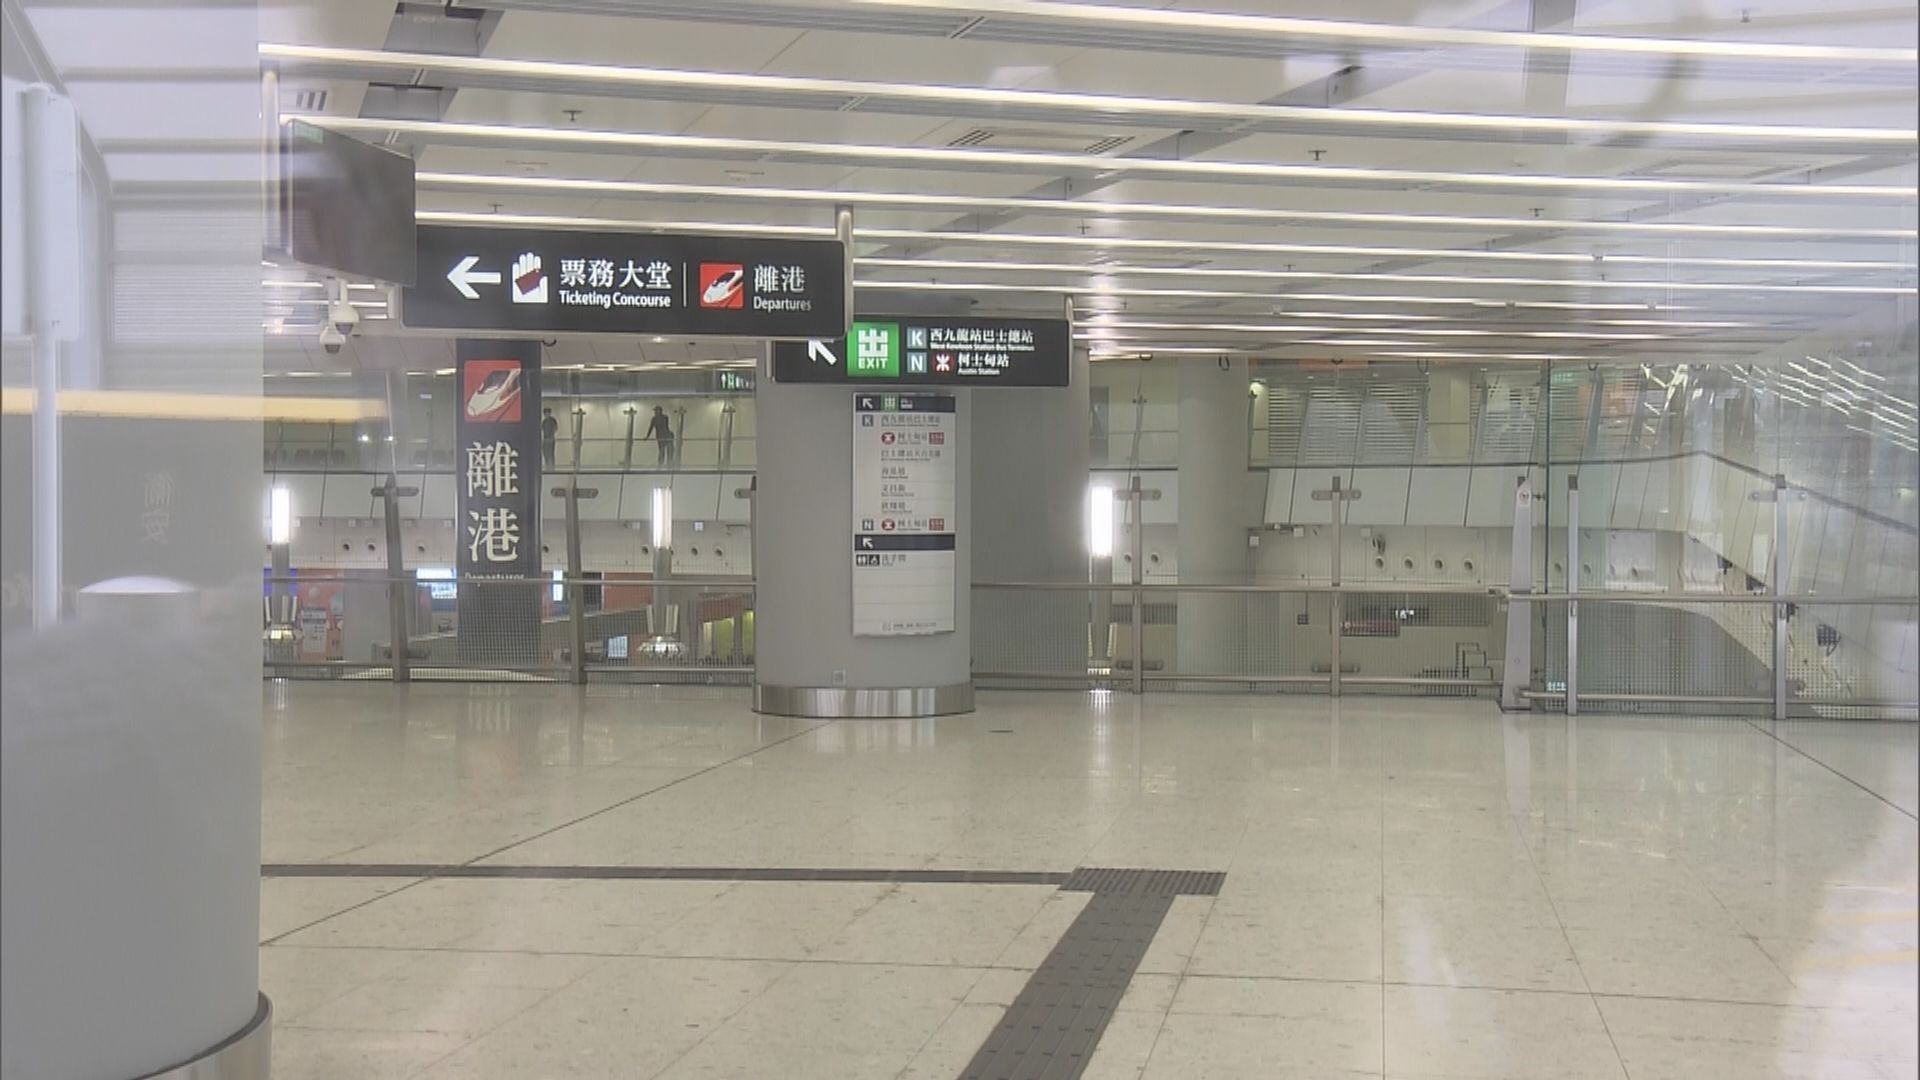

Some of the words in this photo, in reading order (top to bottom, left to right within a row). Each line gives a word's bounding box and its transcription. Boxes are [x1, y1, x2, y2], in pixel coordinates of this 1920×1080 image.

[559, 258, 672, 289] 票務大堂
[754, 264, 805, 293] 離港
[559, 290, 611, 309] Ticketing
[612, 291, 671, 308] Concourse
[753, 296, 812, 313] Departures
[858, 328, 888, 357] 出
[911, 329, 924, 347] K
[929, 327, 1034, 343] 西九龍站巴士總站
[973, 343, 995, 351] Station
[858, 357, 888, 369] EXIT
[911, 355, 923, 371] N
[957, 352, 1010, 368] 柯士甸站
[957, 367, 978, 375] Austin
[978, 368, 1001, 376] Station
[466, 441, 520, 562] 離港
